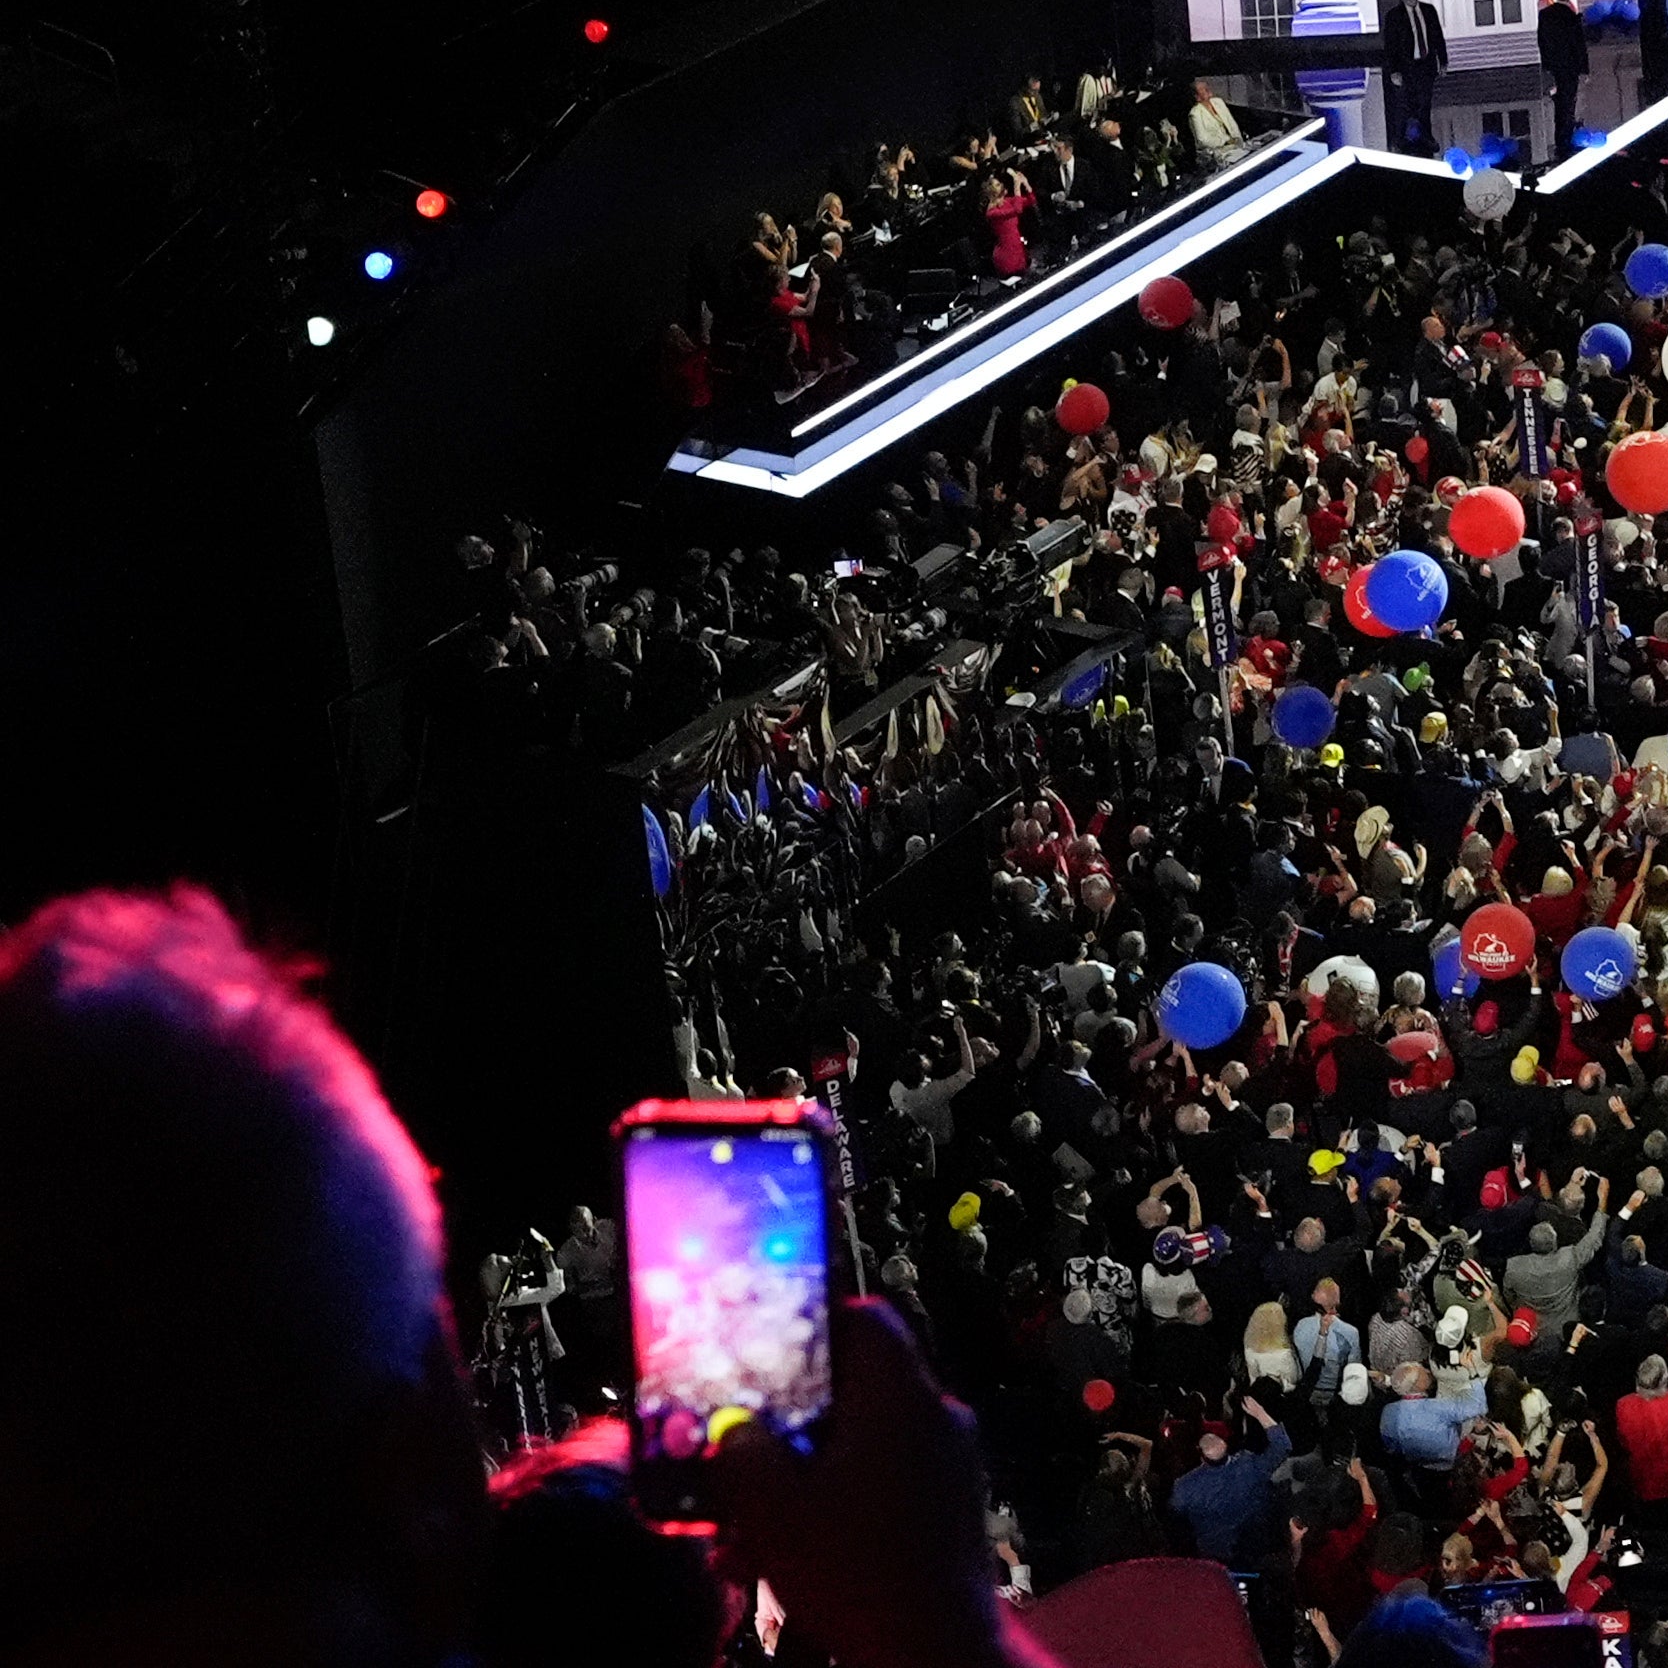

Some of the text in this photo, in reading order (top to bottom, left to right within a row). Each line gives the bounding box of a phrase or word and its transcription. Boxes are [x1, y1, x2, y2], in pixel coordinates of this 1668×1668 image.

[1522, 388, 1539, 474] TENNESSEE
[1207, 569, 1228, 662] VERMONT
[1587, 535, 1600, 628] GEORGIA
[826, 1080, 856, 1189] DELAWARE
[536, 1378, 552, 1439] MEXIC
